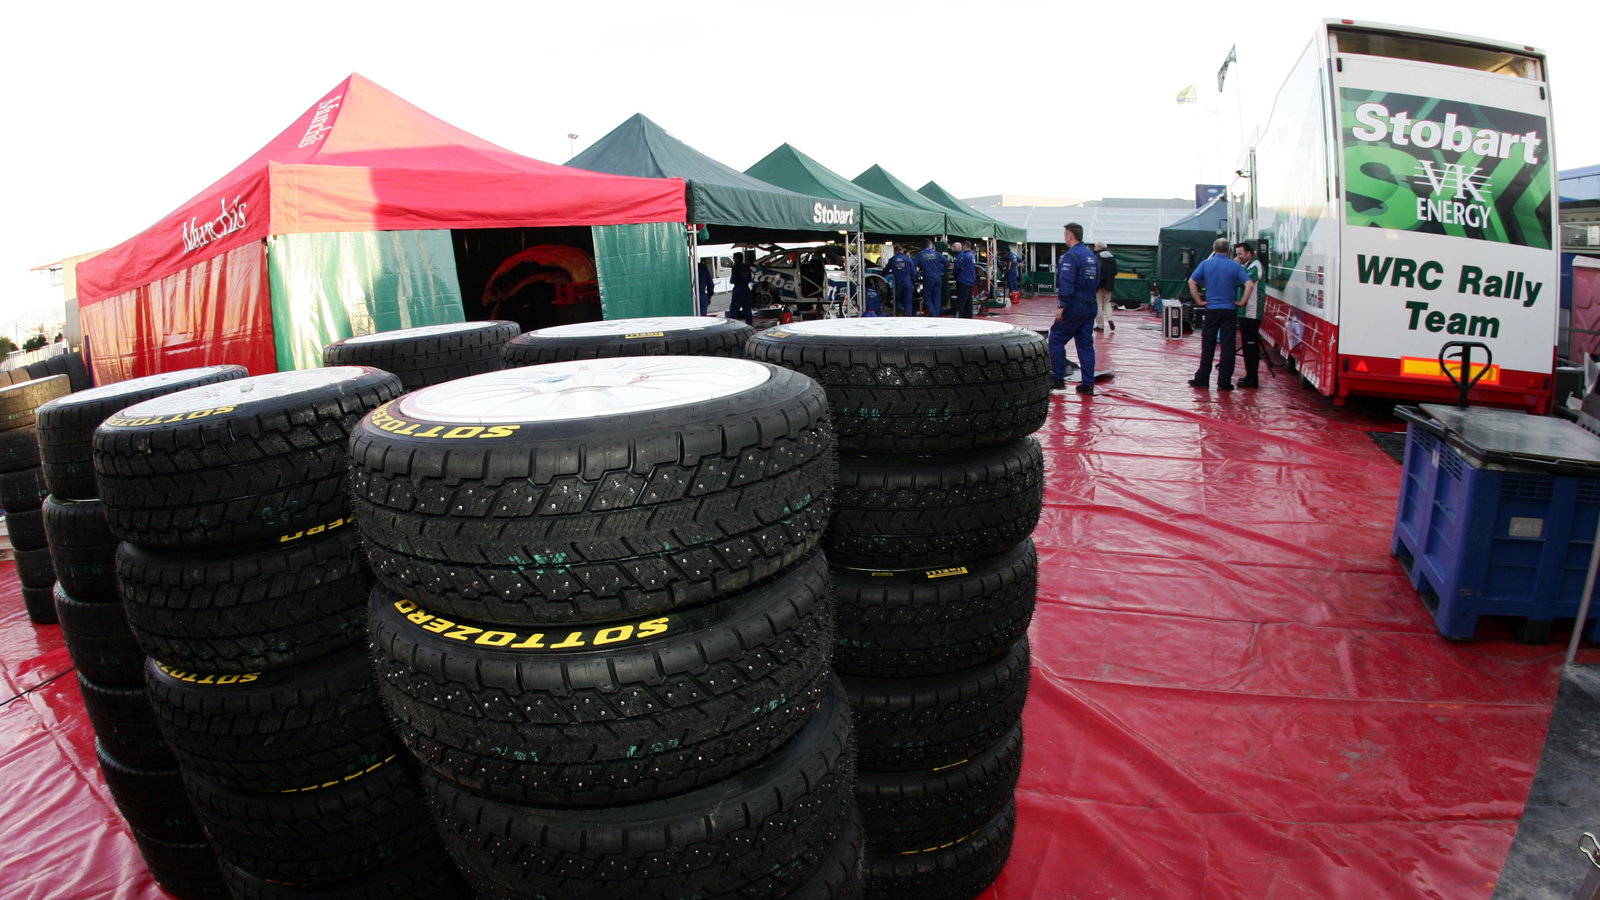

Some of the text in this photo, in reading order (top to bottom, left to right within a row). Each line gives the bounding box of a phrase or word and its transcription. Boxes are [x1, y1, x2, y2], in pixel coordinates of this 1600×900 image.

[1352, 102, 1542, 165] Stobart
[1415, 159, 1492, 202] VK
[813, 202, 854, 225] Stobart
[1417, 197, 1491, 229] ENERGY
[1357, 254, 1444, 290] WRC
[1457, 265, 1543, 308] Rally
[1405, 300, 1500, 339] Team
